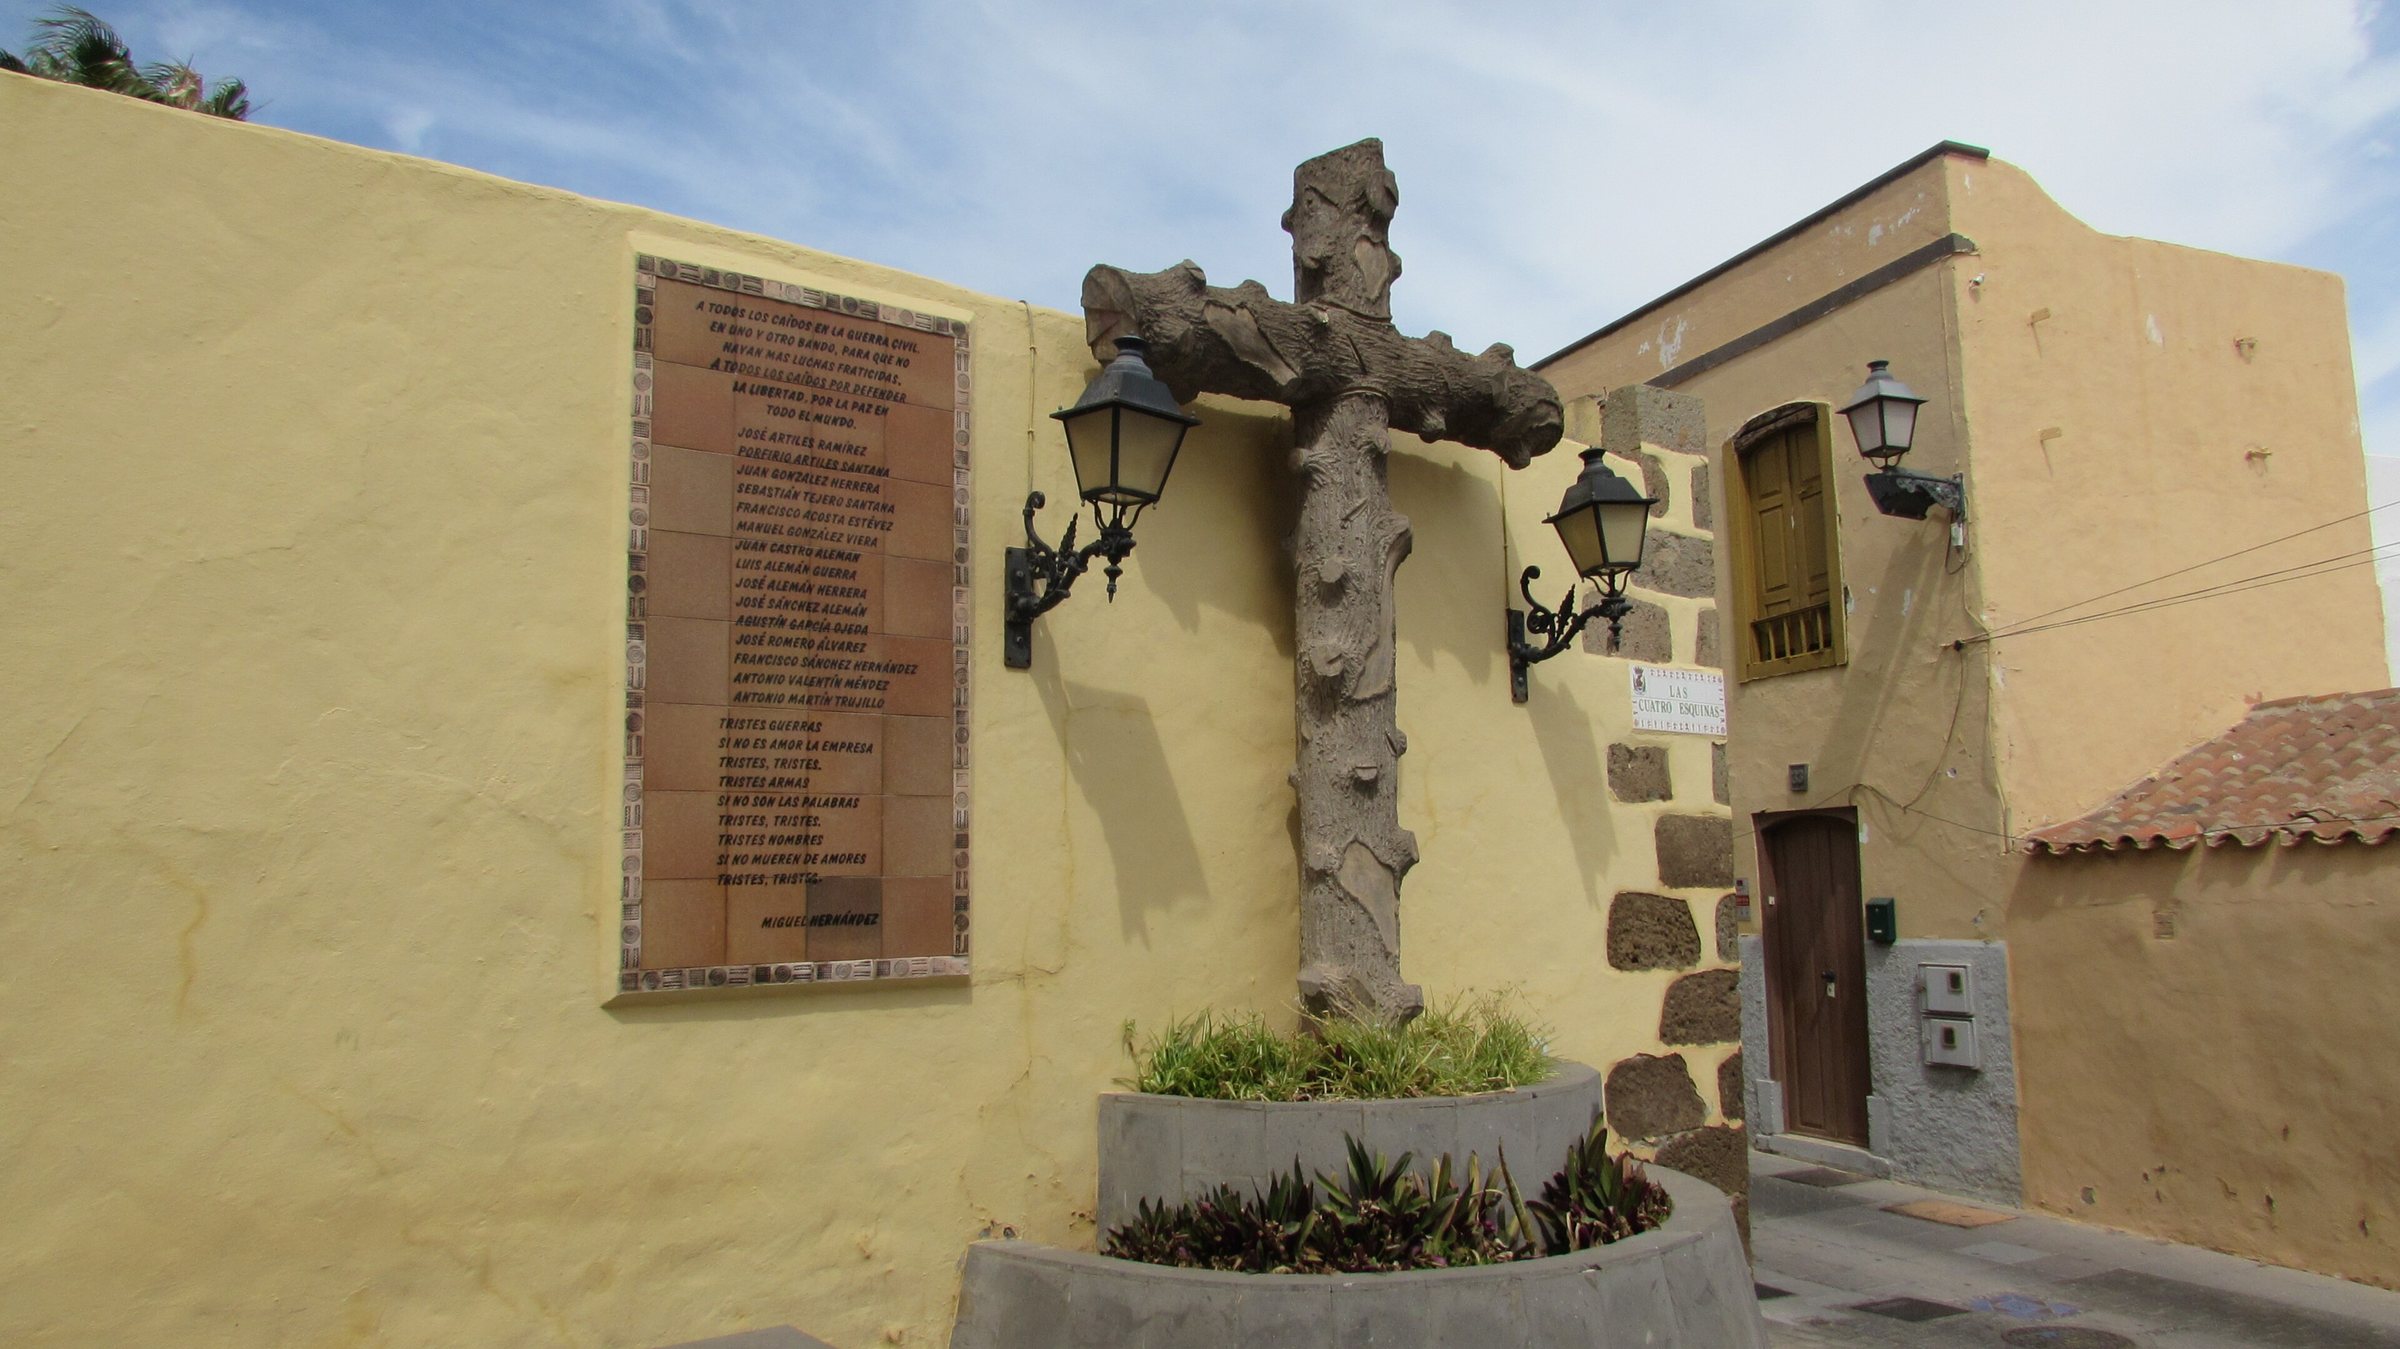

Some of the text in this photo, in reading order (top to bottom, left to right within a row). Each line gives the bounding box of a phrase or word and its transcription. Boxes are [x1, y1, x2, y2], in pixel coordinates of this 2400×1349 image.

[696, 302, 704, 311] A
[709, 303, 745, 318] TODOS
[749, 309, 768, 323] LOS
[772, 314, 811, 331] CAÍDOS
[815, 323, 827, 334] EN
[832, 326, 844, 337] LA
[847, 330, 889, 348] GUERRA
[710, 322, 724, 333] EN
[728, 324, 752, 338] UNO
[757, 330, 763, 339] Y
[766, 332, 795, 346] OTRO
[842, 346, 869, 361] PARA
[872, 353, 893, 364] QUE
[896, 358, 909, 368] NO
[766, 350, 789, 363] MAS
[792, 356, 834, 372] LUCHAS
[710, 358, 907, 403] A TODOS LOS CAÍDOS POR DEFENDER
[733, 382, 746, 393] LA
[811, 394, 833, 408] POR
[835, 399, 848, 410] LA
[851, 401, 872, 414] PAZ
[875, 406, 888, 416] EN
[767, 405, 796, 418] TODO
[798, 410, 812, 420] EL
[737, 427, 767, 440] JOSÉ
[769, 434, 814, 448] ARTILES
[737, 446, 890, 478] PORFIRIO ARTILES SANTANA
[737, 465, 768, 478] JUAN
[831, 478, 880, 494] HERRERA
[737, 483, 894, 514] SEBASTIÁN TEJERO SANTANA
[737, 502, 893, 531] FRANCISCO ACOSTA ESTÉVEZ
[736, 521, 878, 548] MANUEL GONZÁLEZ VIERA
[735, 539, 768, 551] JUAN
[770, 543, 813, 557] CASTRO
[736, 558, 857, 580] LUIS ALEMÁN GUERRA
[736, 575, 867, 599] JOSÉ ALEMÁN HERRERA
[736, 594, 867, 617] JOSÉ SÁNCHEZ ALEMÁN
[735, 615, 868, 636] AGUSTÍN GARCÍA OJEDA
[735, 632, 867, 653] JOSÉ ROMERO ÁLVAREZ
[734, 653, 918, 675] FRANCISCO SÁNCHEZ HERNÁNDEZ
[733, 672, 890, 690] ANTONIO VALENTÍN MÉNDEZ
[1669, 685, 1688, 698] LAS
[734, 691, 884, 708] ANTONIO MARTÍN TRUJILLO
[1638, 699, 1719, 718] CUATRO ESQUINAS
[719, 719, 822, 732] TRISTES GUERRAS
[718, 738, 873, 754] SI NO ES AMOR LA EMPRESA
[719, 757, 821, 770] TRISTES, TRISTES.
[719, 776, 810, 788] TRISTES ARMAS
[717, 796, 860, 808] SI NO SON LAS PALABRAS
[718, 815, 821, 827] TRISTES, TRISTES.
[717, 834, 823, 846] TRISTES NOMBRES
[716, 854, 866, 865] SI NO MUEREN DE AMORES
[717, 874, 768, 886] TRISTES,
[762, 911, 879, 928] MIGUEL HERNÁNDEZ
